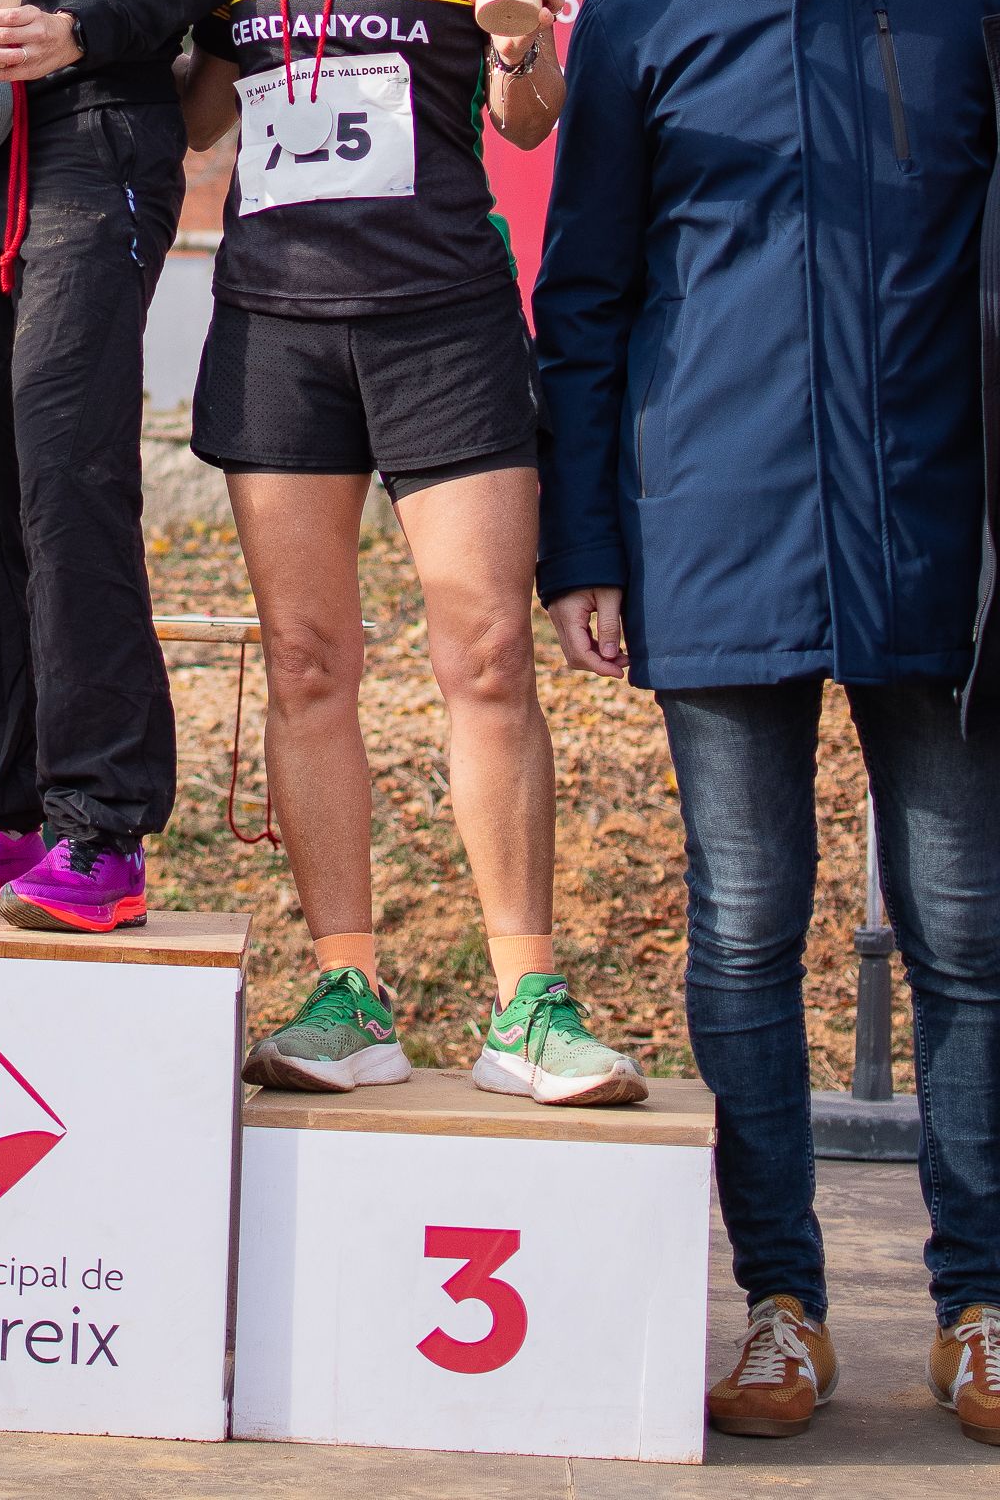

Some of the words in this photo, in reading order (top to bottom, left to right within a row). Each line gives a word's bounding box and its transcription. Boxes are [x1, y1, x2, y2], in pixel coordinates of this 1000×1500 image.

[231, 14, 430, 46] CERDANYOLA
[246, 88, 254, 98] IX
[255, 82, 277, 96] MILLA
[321, 70, 335, 78] DE
[338, 65, 400, 77] VALLDOREIX
[82, 1258, 124, 1291] de
[416, 1225, 528, 1375] 3
